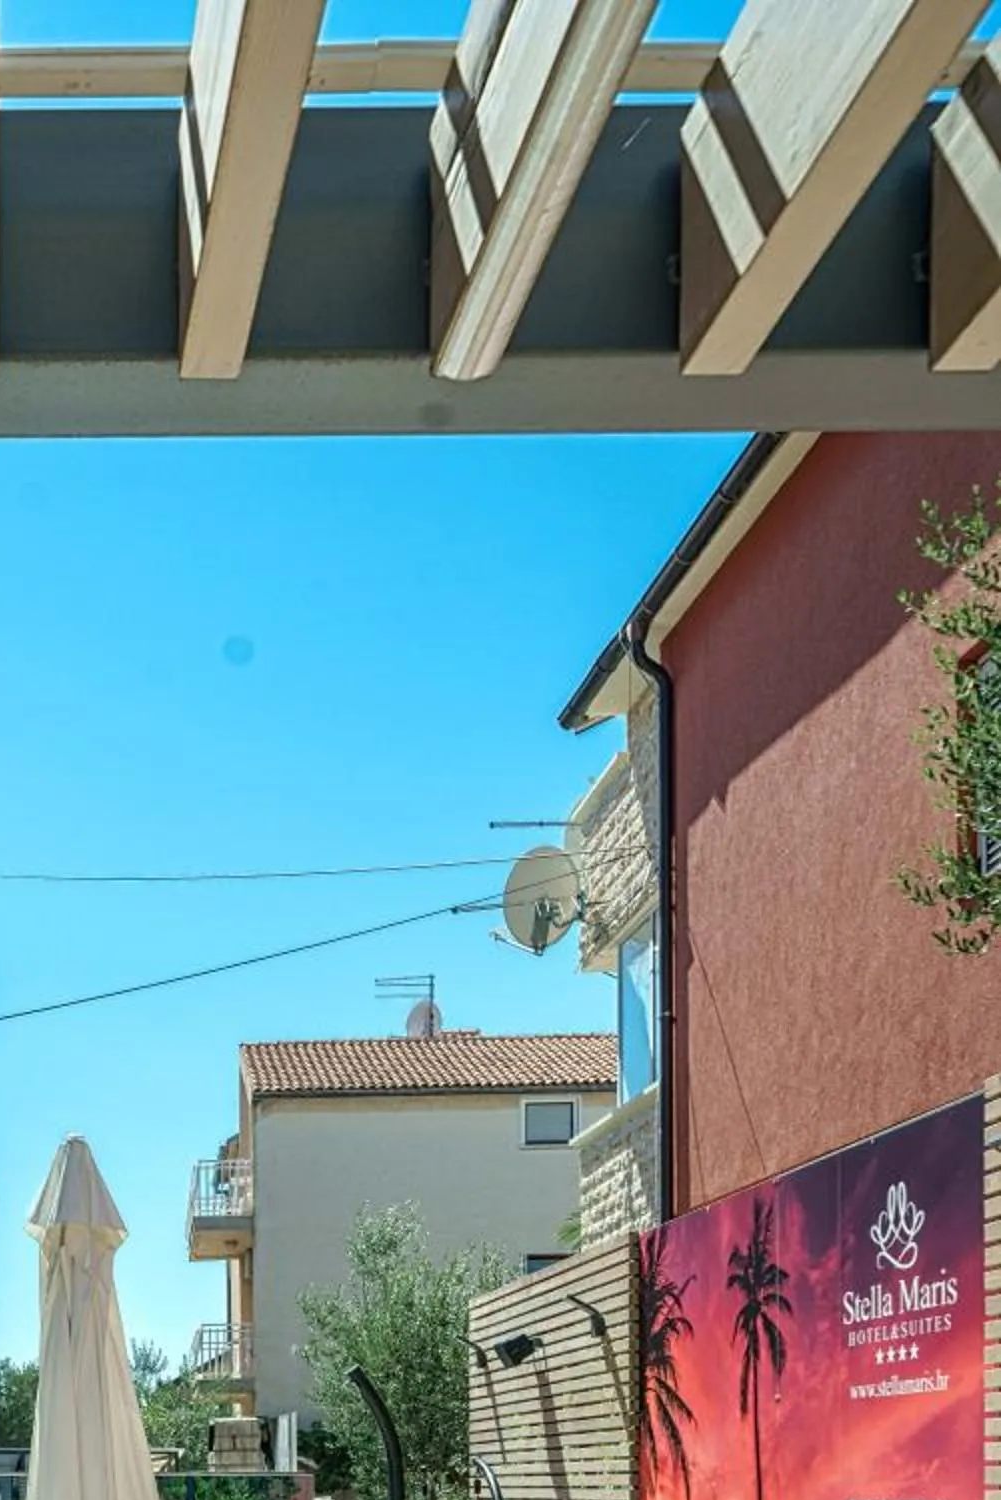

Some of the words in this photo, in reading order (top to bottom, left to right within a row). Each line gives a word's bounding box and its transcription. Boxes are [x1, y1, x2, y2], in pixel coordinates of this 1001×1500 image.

[842, 1283, 894, 1325] Stella
[898, 1267, 959, 1315] Maris
[850, 1368, 950, 1400] www.stellamaris.hr
